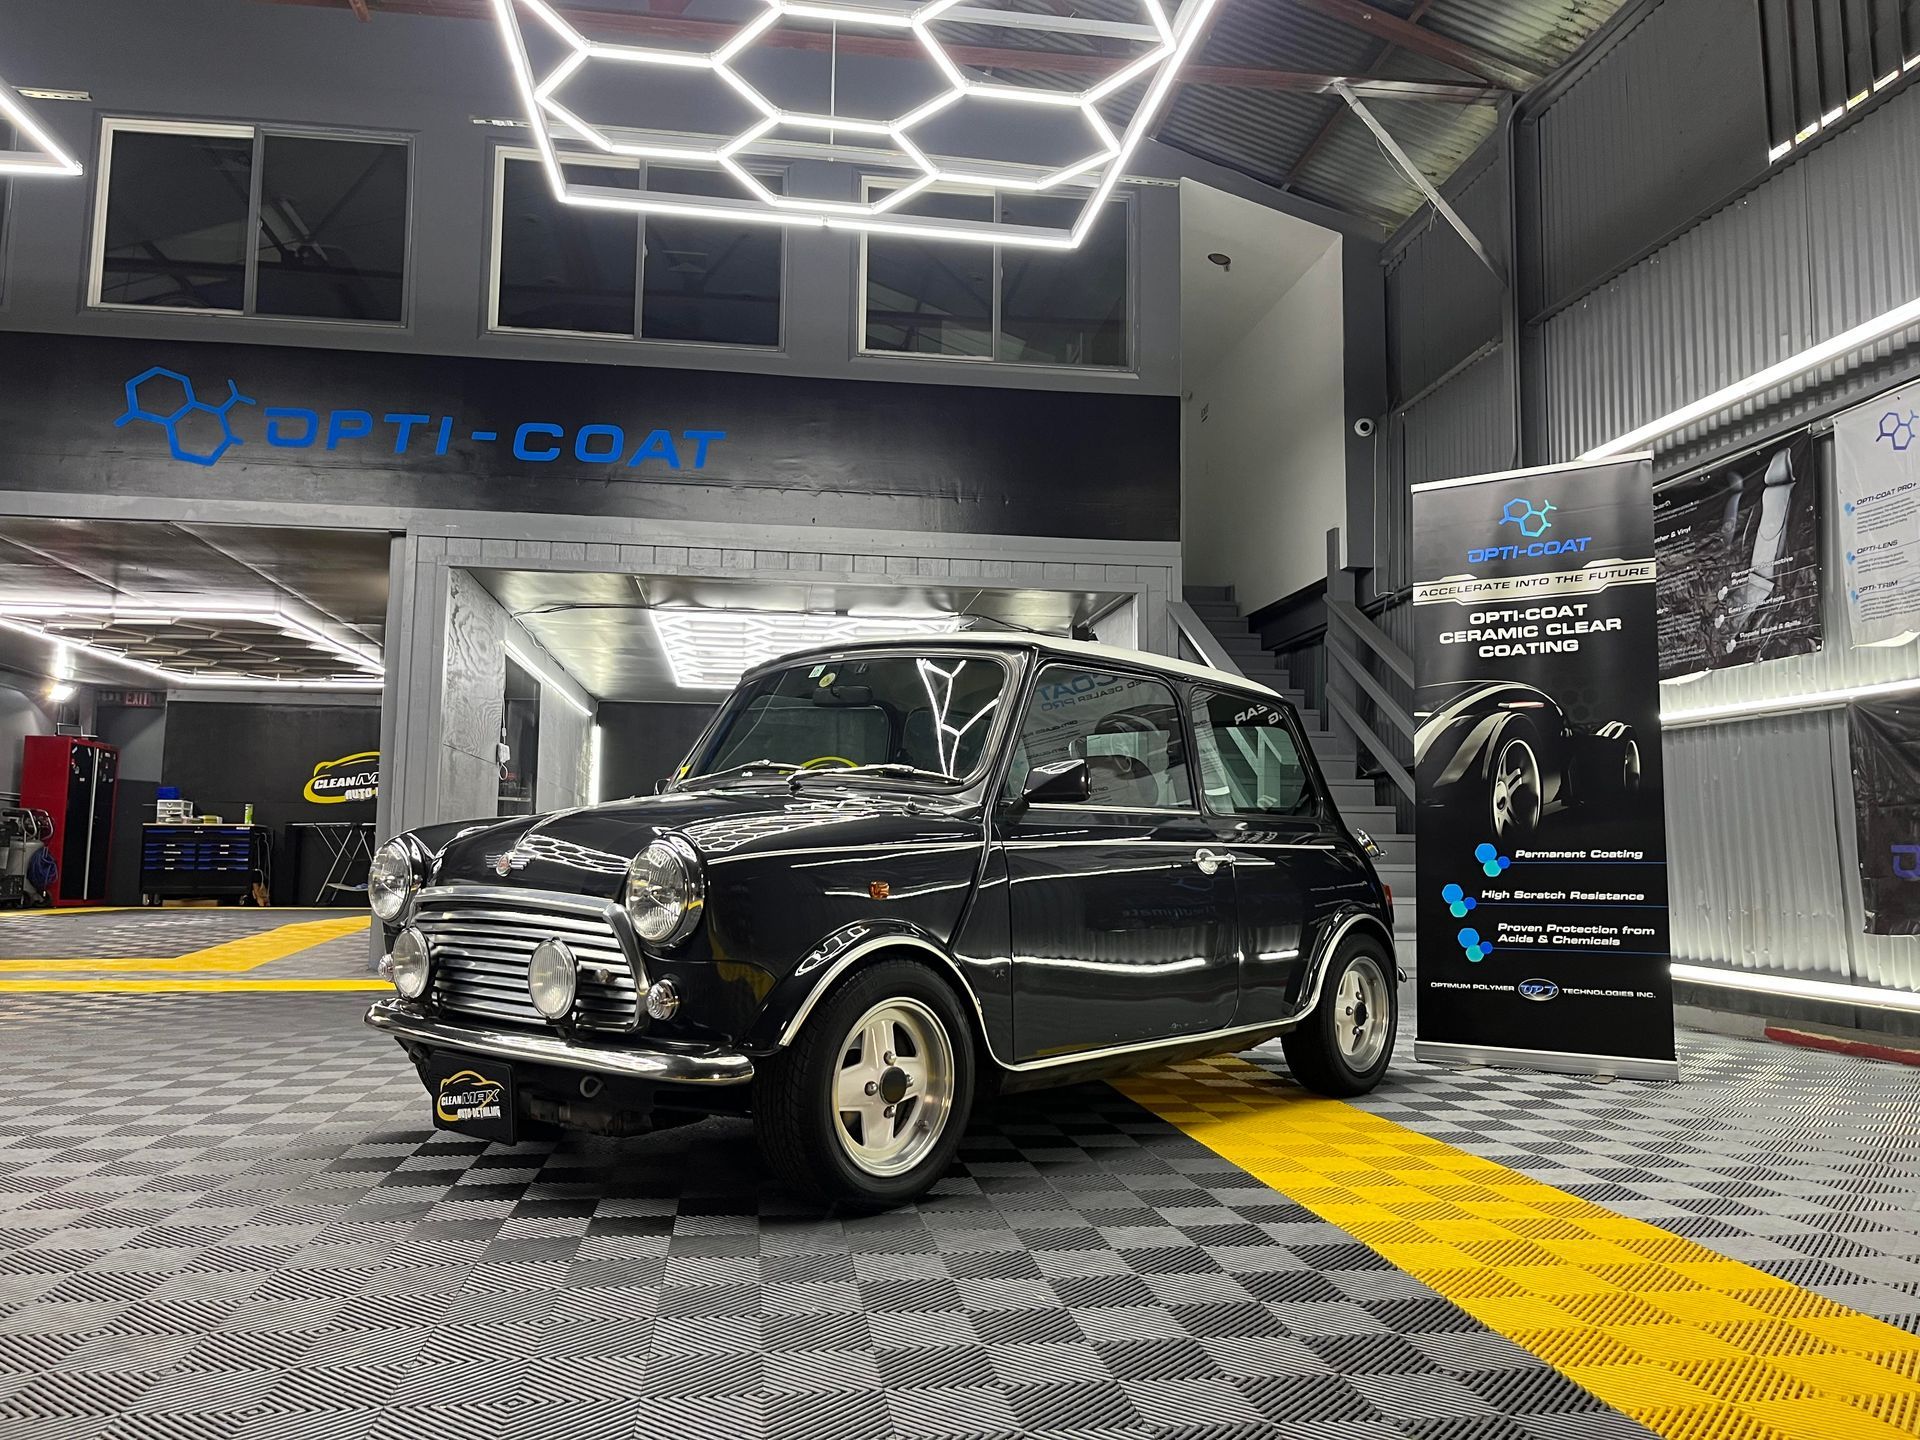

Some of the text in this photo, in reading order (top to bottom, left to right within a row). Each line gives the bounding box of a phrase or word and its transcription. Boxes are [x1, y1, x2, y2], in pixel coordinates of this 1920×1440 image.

[265, 407, 727, 469] OPTI-COAT
[1856, 488, 1895, 505] OPTI-COAT
[1467, 537, 1591, 563] OPTI-COAT
[1857, 539, 1898, 554] OPTI-LENS
[1418, 567, 1650, 598] ACCELERATE INTO THE FUTURE
[1859, 580, 1898, 593] OPTI-TRIM
[1469, 603, 1588, 625] OPTI-COAT
[1439, 618, 1622, 644] CERAMIC CLEAR
[1478, 639, 1579, 658] COATING
[126, 691, 150, 705] EXIT
[1515, 849, 1643, 860] Permanent Coating
[1481, 889, 1645, 901] High Scratch Resistance
[1497, 923, 1656, 936] Proven Protection from
[1497, 934, 1621, 946] Acids & Chemicals
[1430, 981, 1471, 990] OPTIMUM
[1472, 983, 1515, 992] POLYMER
[1562, 987, 1634, 997] TECHNOLOGIES
